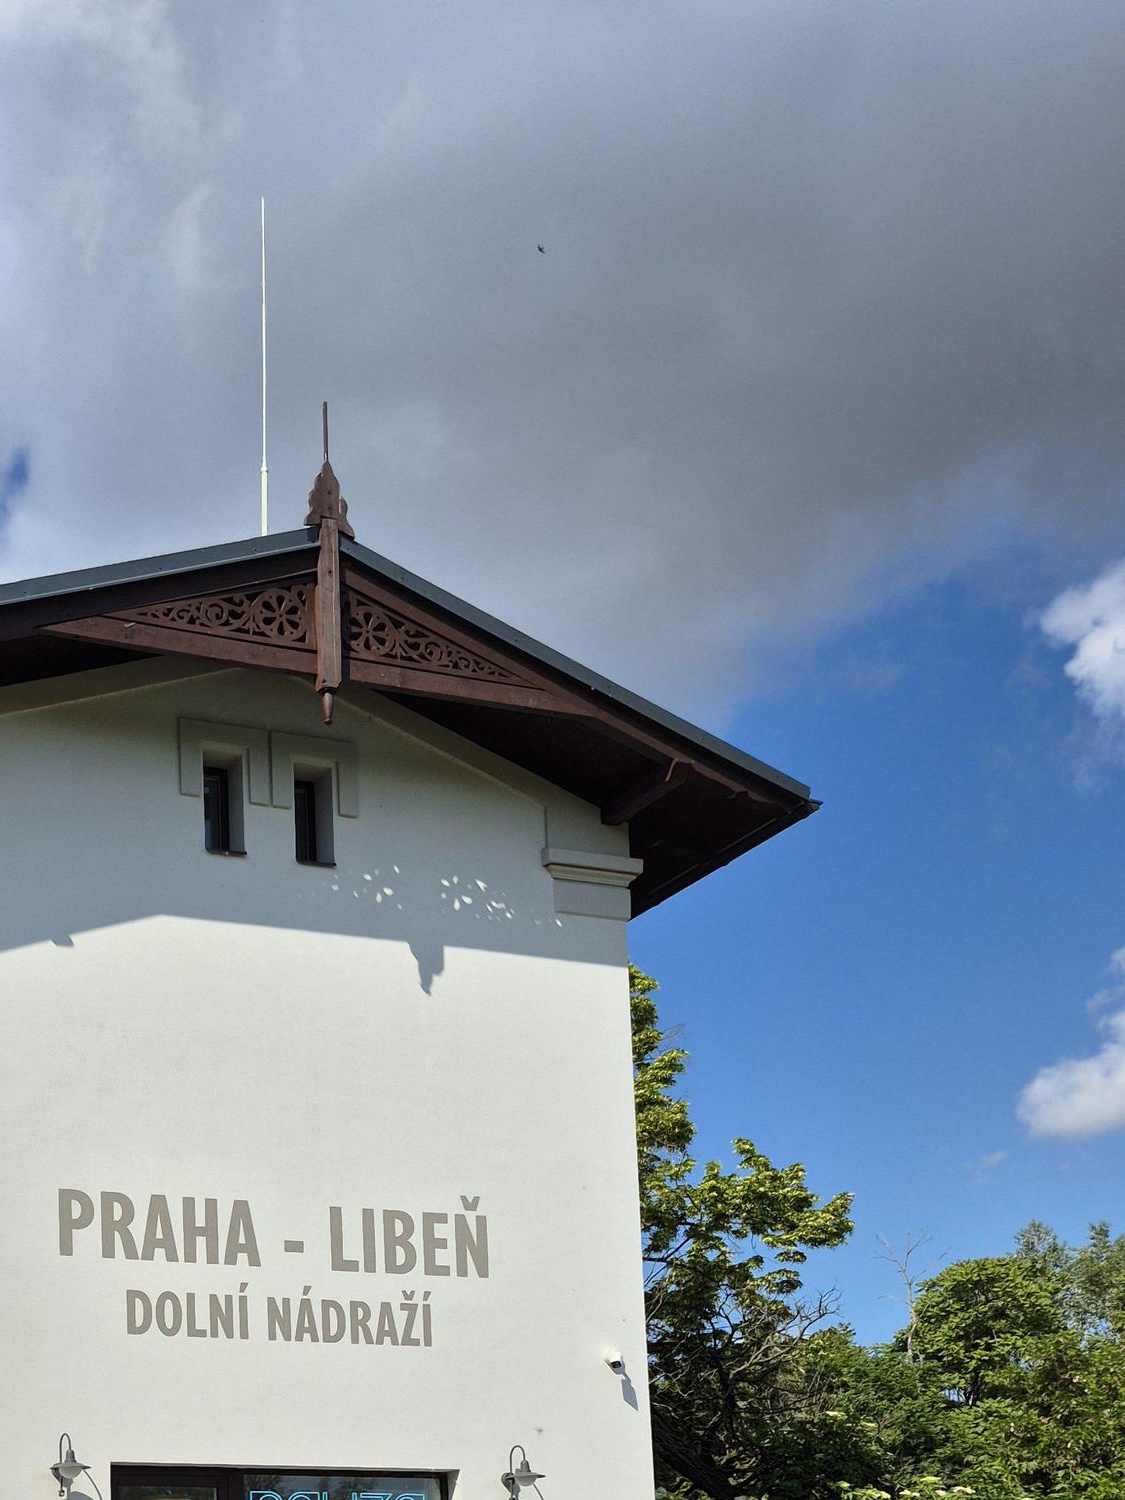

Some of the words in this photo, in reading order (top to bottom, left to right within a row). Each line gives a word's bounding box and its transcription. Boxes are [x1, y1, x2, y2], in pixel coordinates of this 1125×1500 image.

[58, 1188, 262, 1267] PRAHA
[284, 1240, 304, 1253] -
[329, 1195, 489, 1278] LIBEŇ
[125, 1282, 249, 1340] DOLNÍ
[266, 1285, 433, 1347] NÁDRAŽÍ
